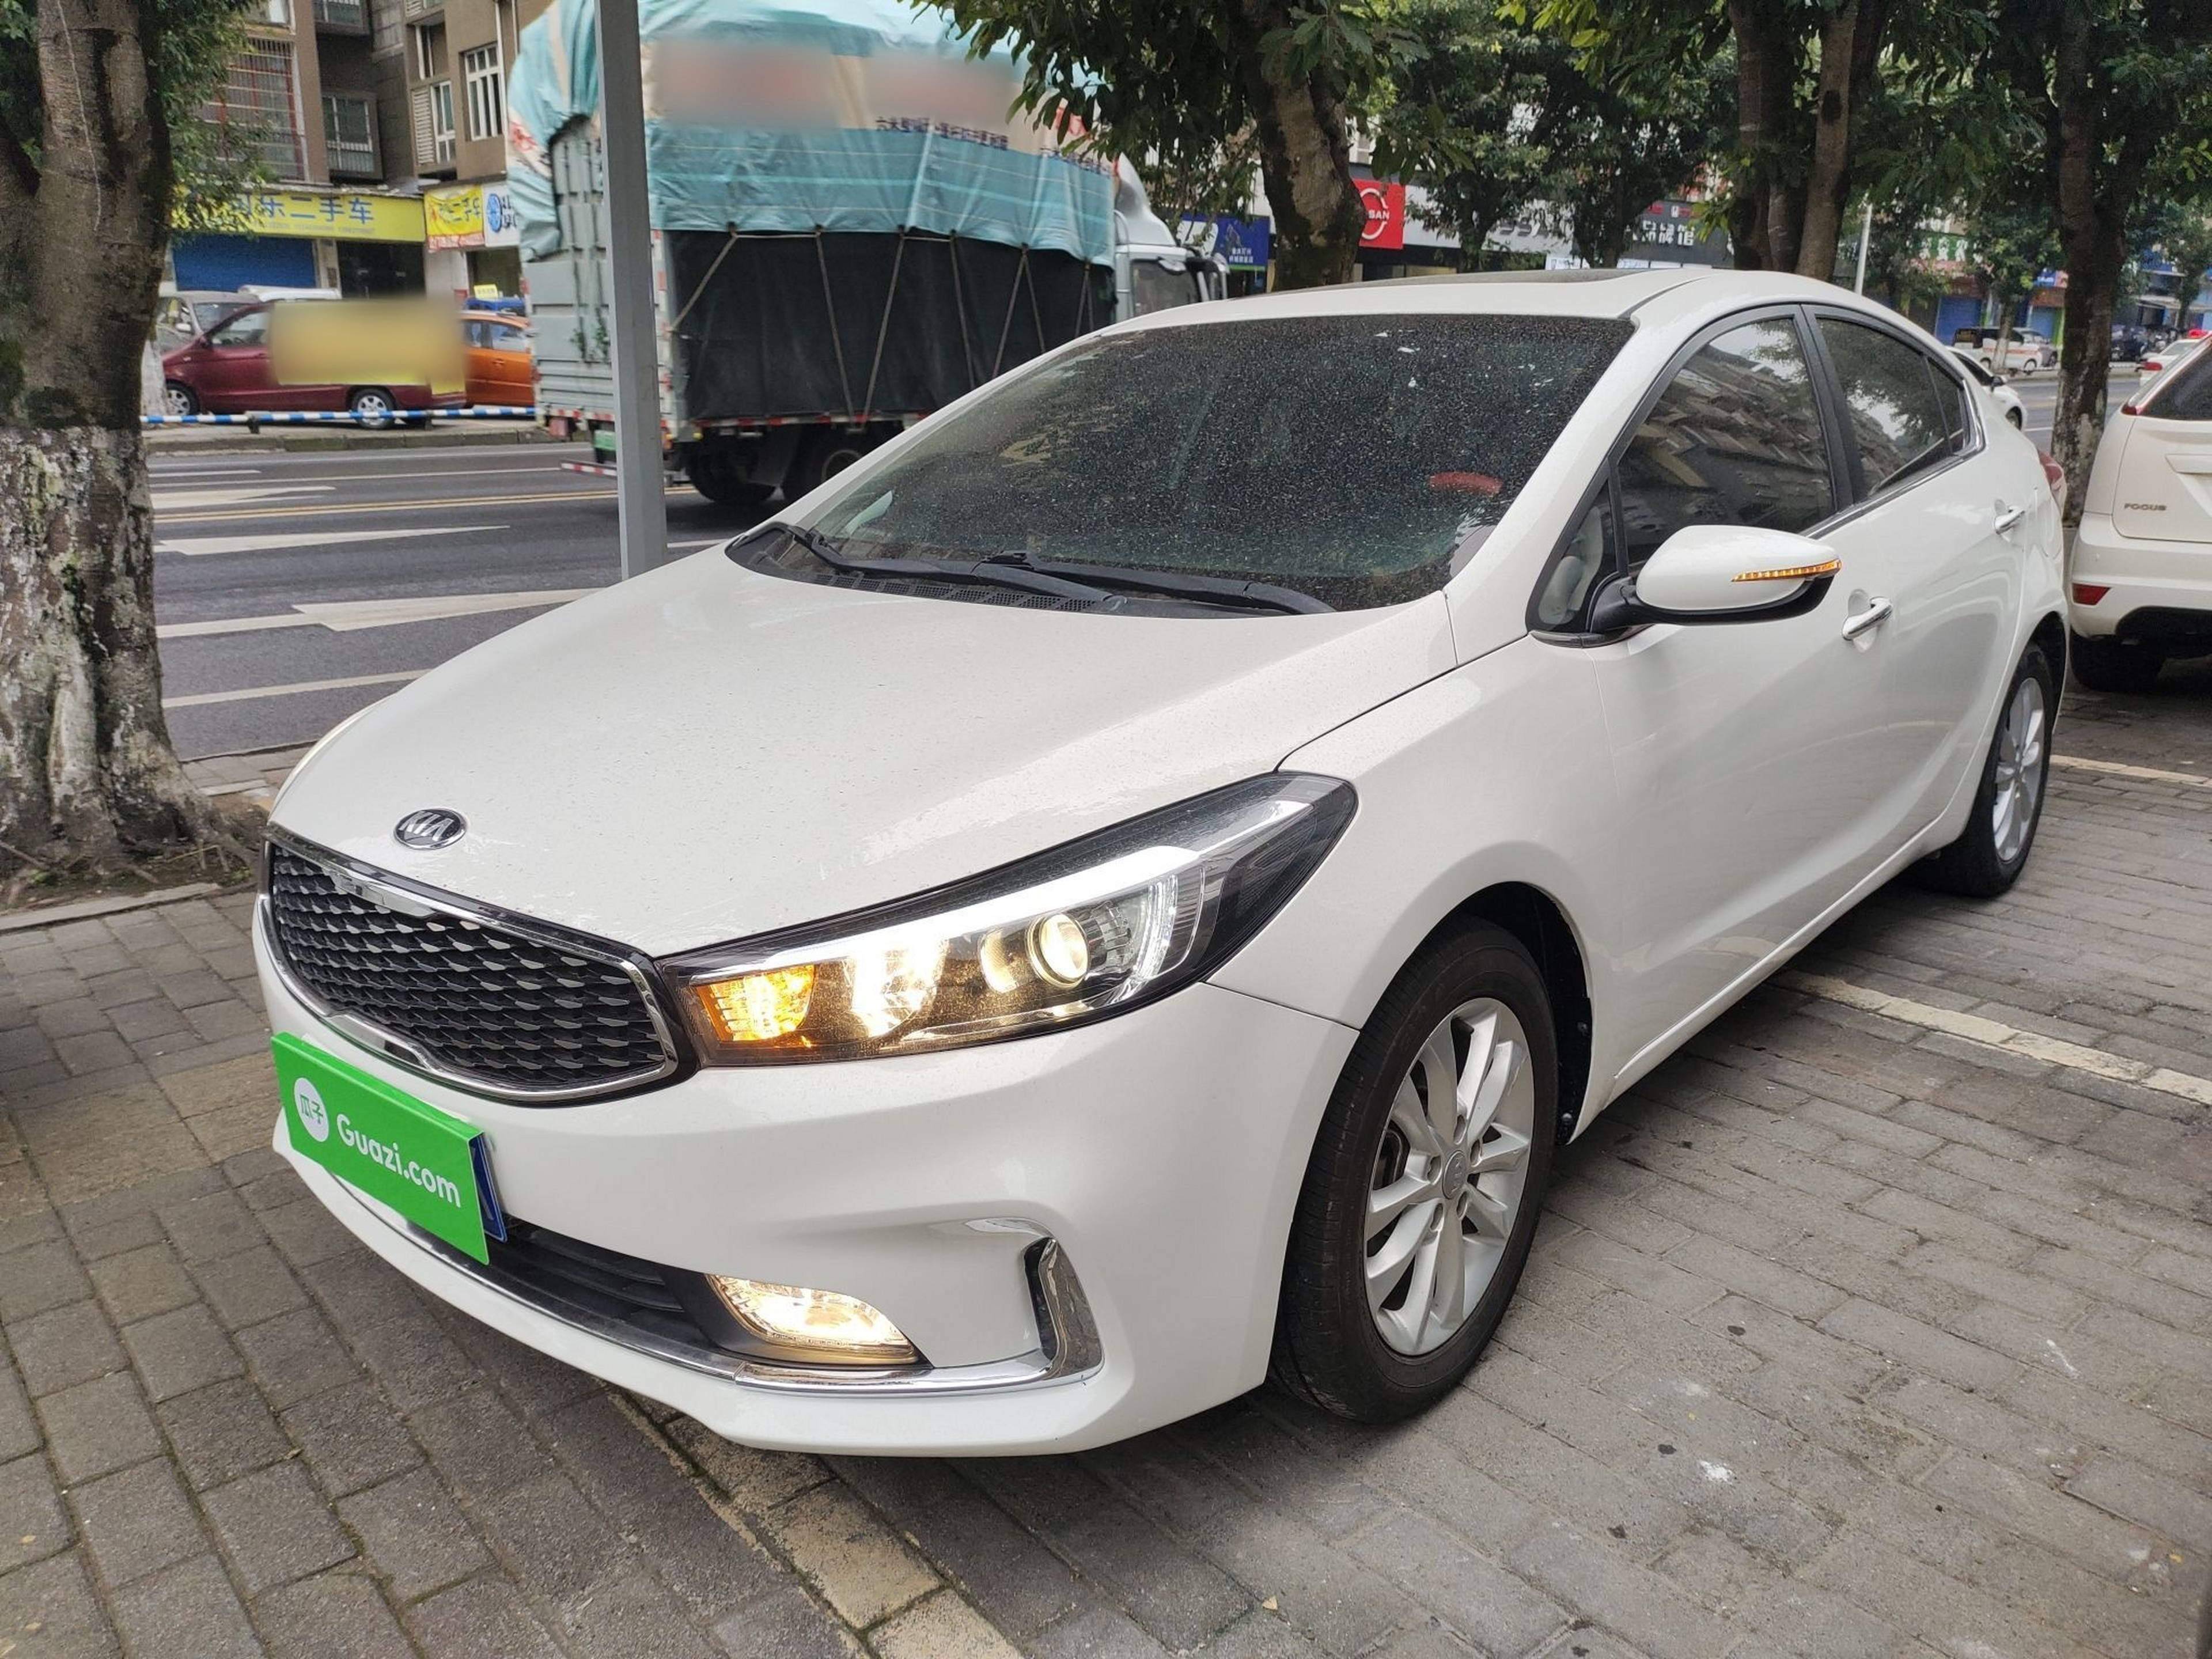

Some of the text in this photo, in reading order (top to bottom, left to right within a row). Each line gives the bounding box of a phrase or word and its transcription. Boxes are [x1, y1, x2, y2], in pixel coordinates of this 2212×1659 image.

[1368, 209, 1390, 221] SAN
[2124, 502, 2167, 512] FOCUS
[398, 810, 454, 842] KIA
[298, 1092, 324, 1124] 瓜子
[336, 1113, 461, 1208] Guazi.com
